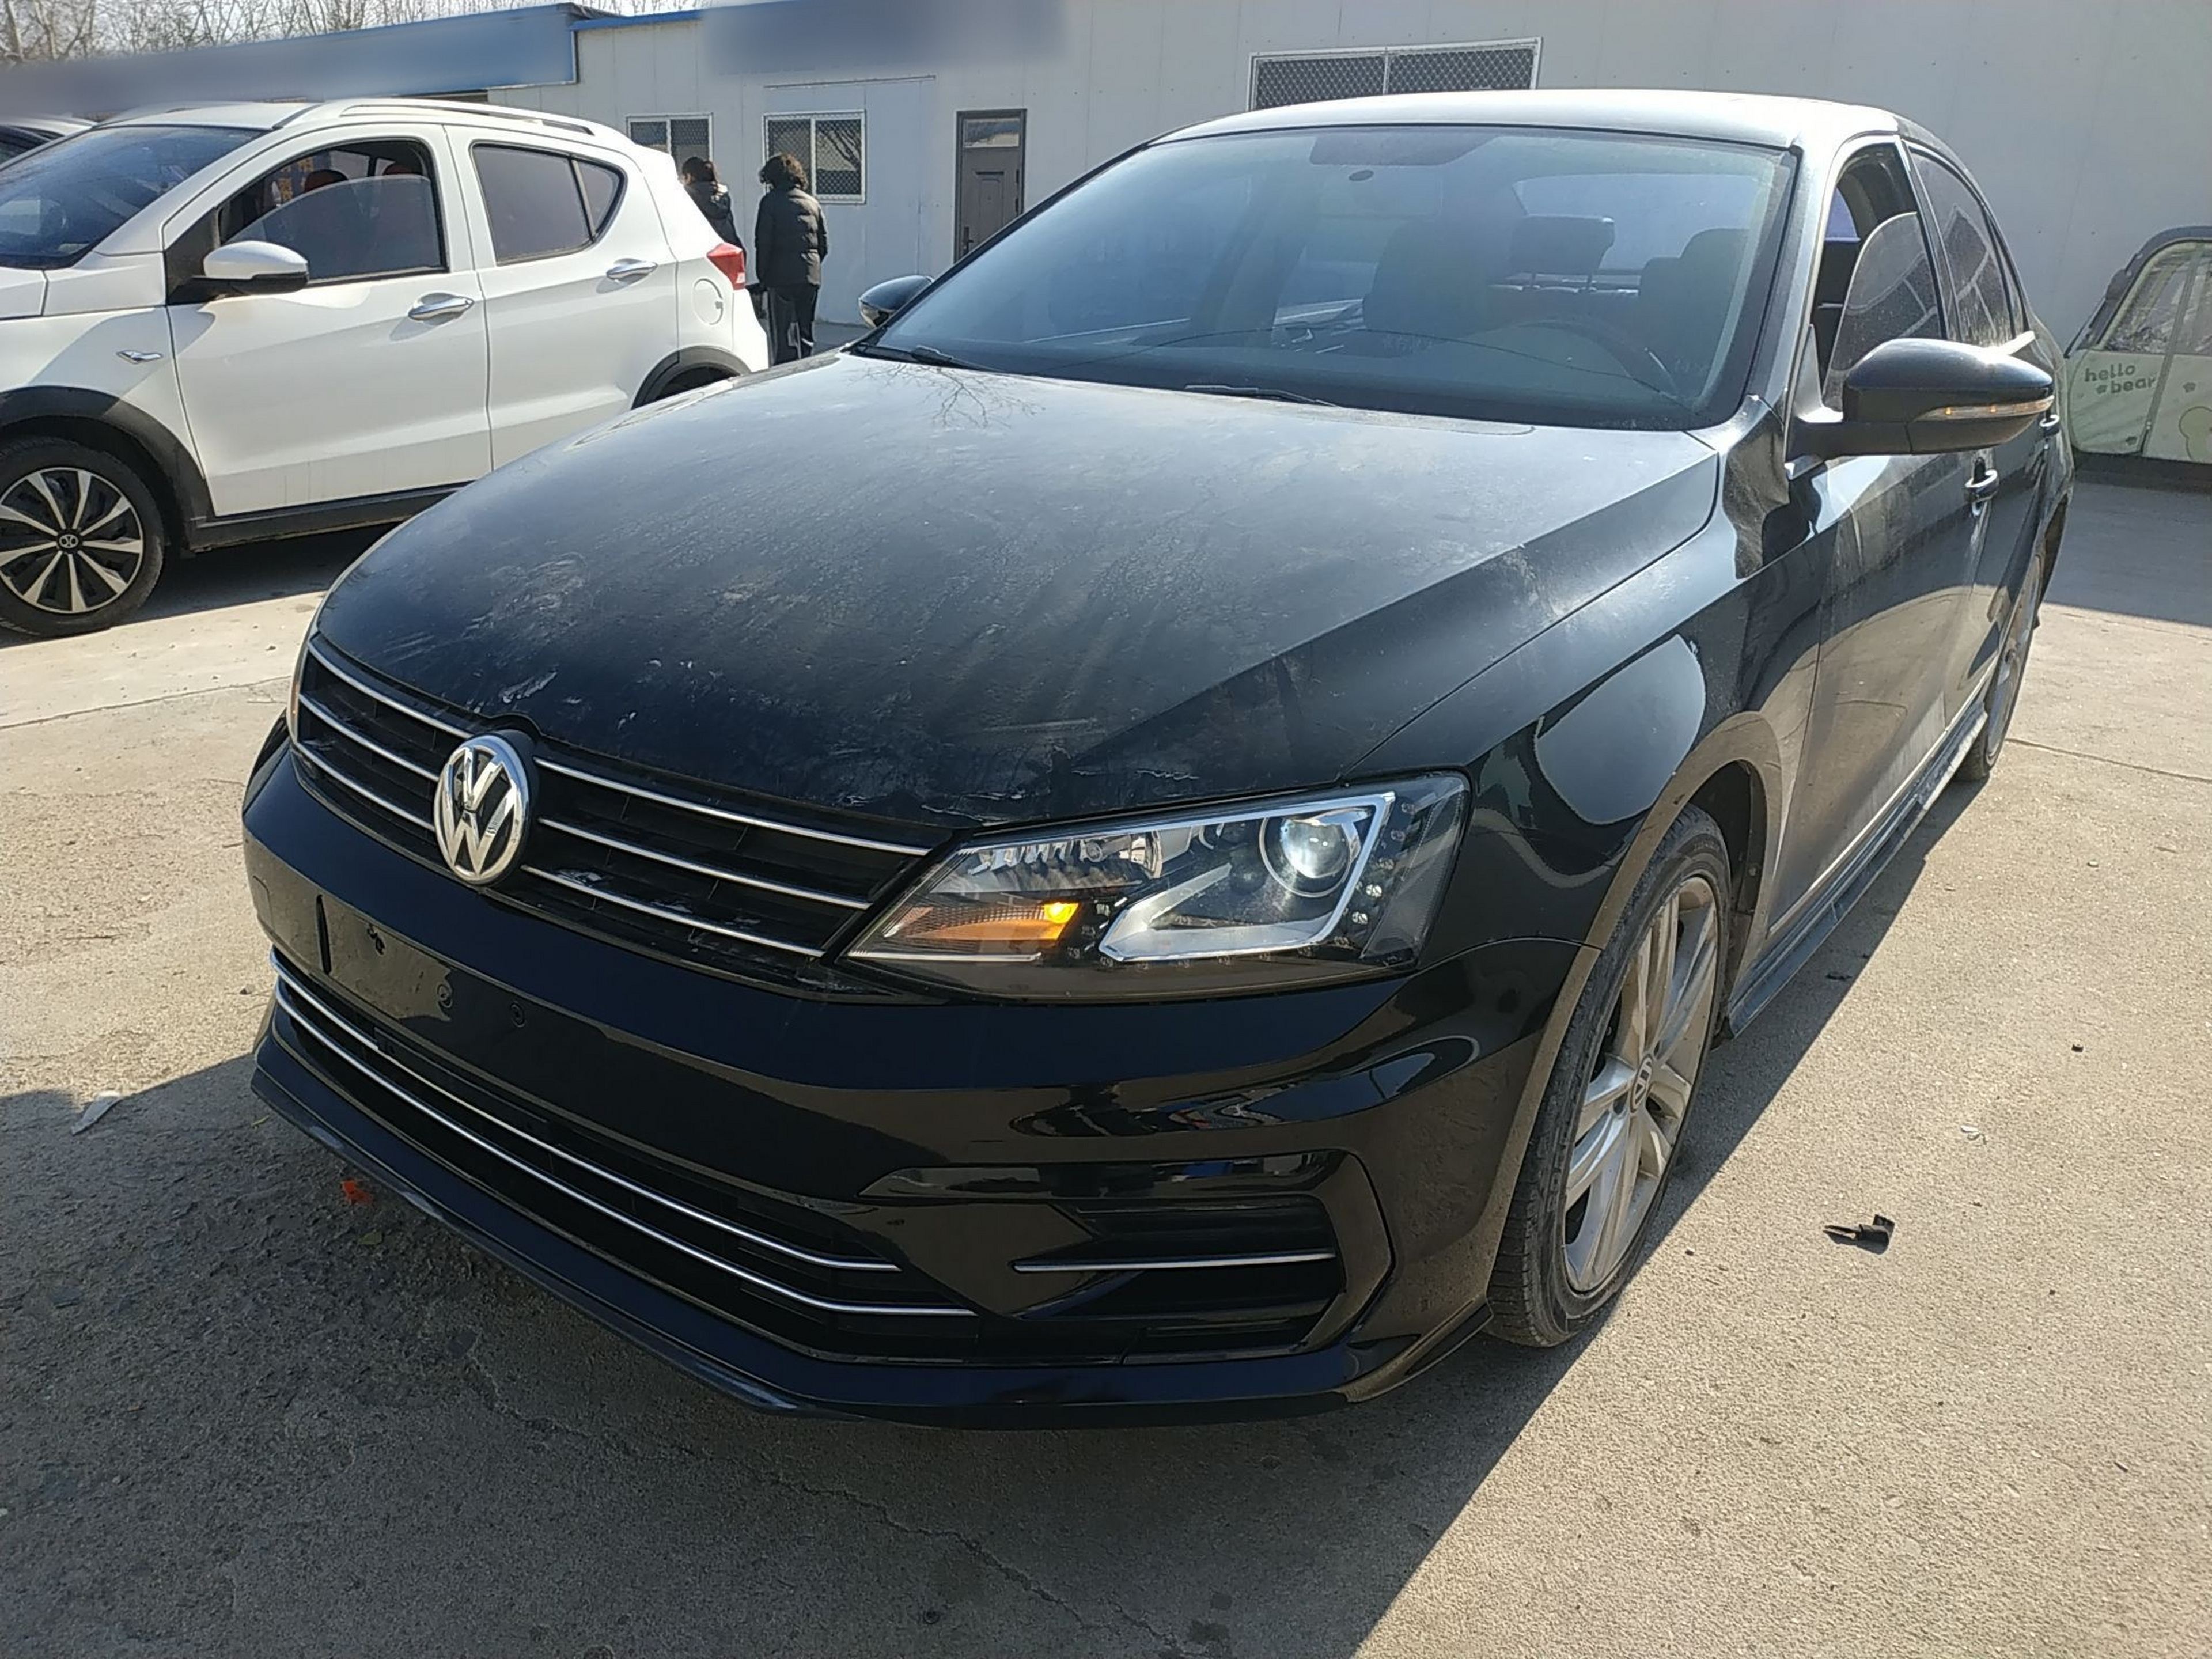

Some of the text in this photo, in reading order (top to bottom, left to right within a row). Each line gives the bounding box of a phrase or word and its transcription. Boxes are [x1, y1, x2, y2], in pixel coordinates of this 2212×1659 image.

[2085, 362, 2136, 382] hello
[2110, 376, 2156, 394] bear
[436, 739, 526, 882] VW
